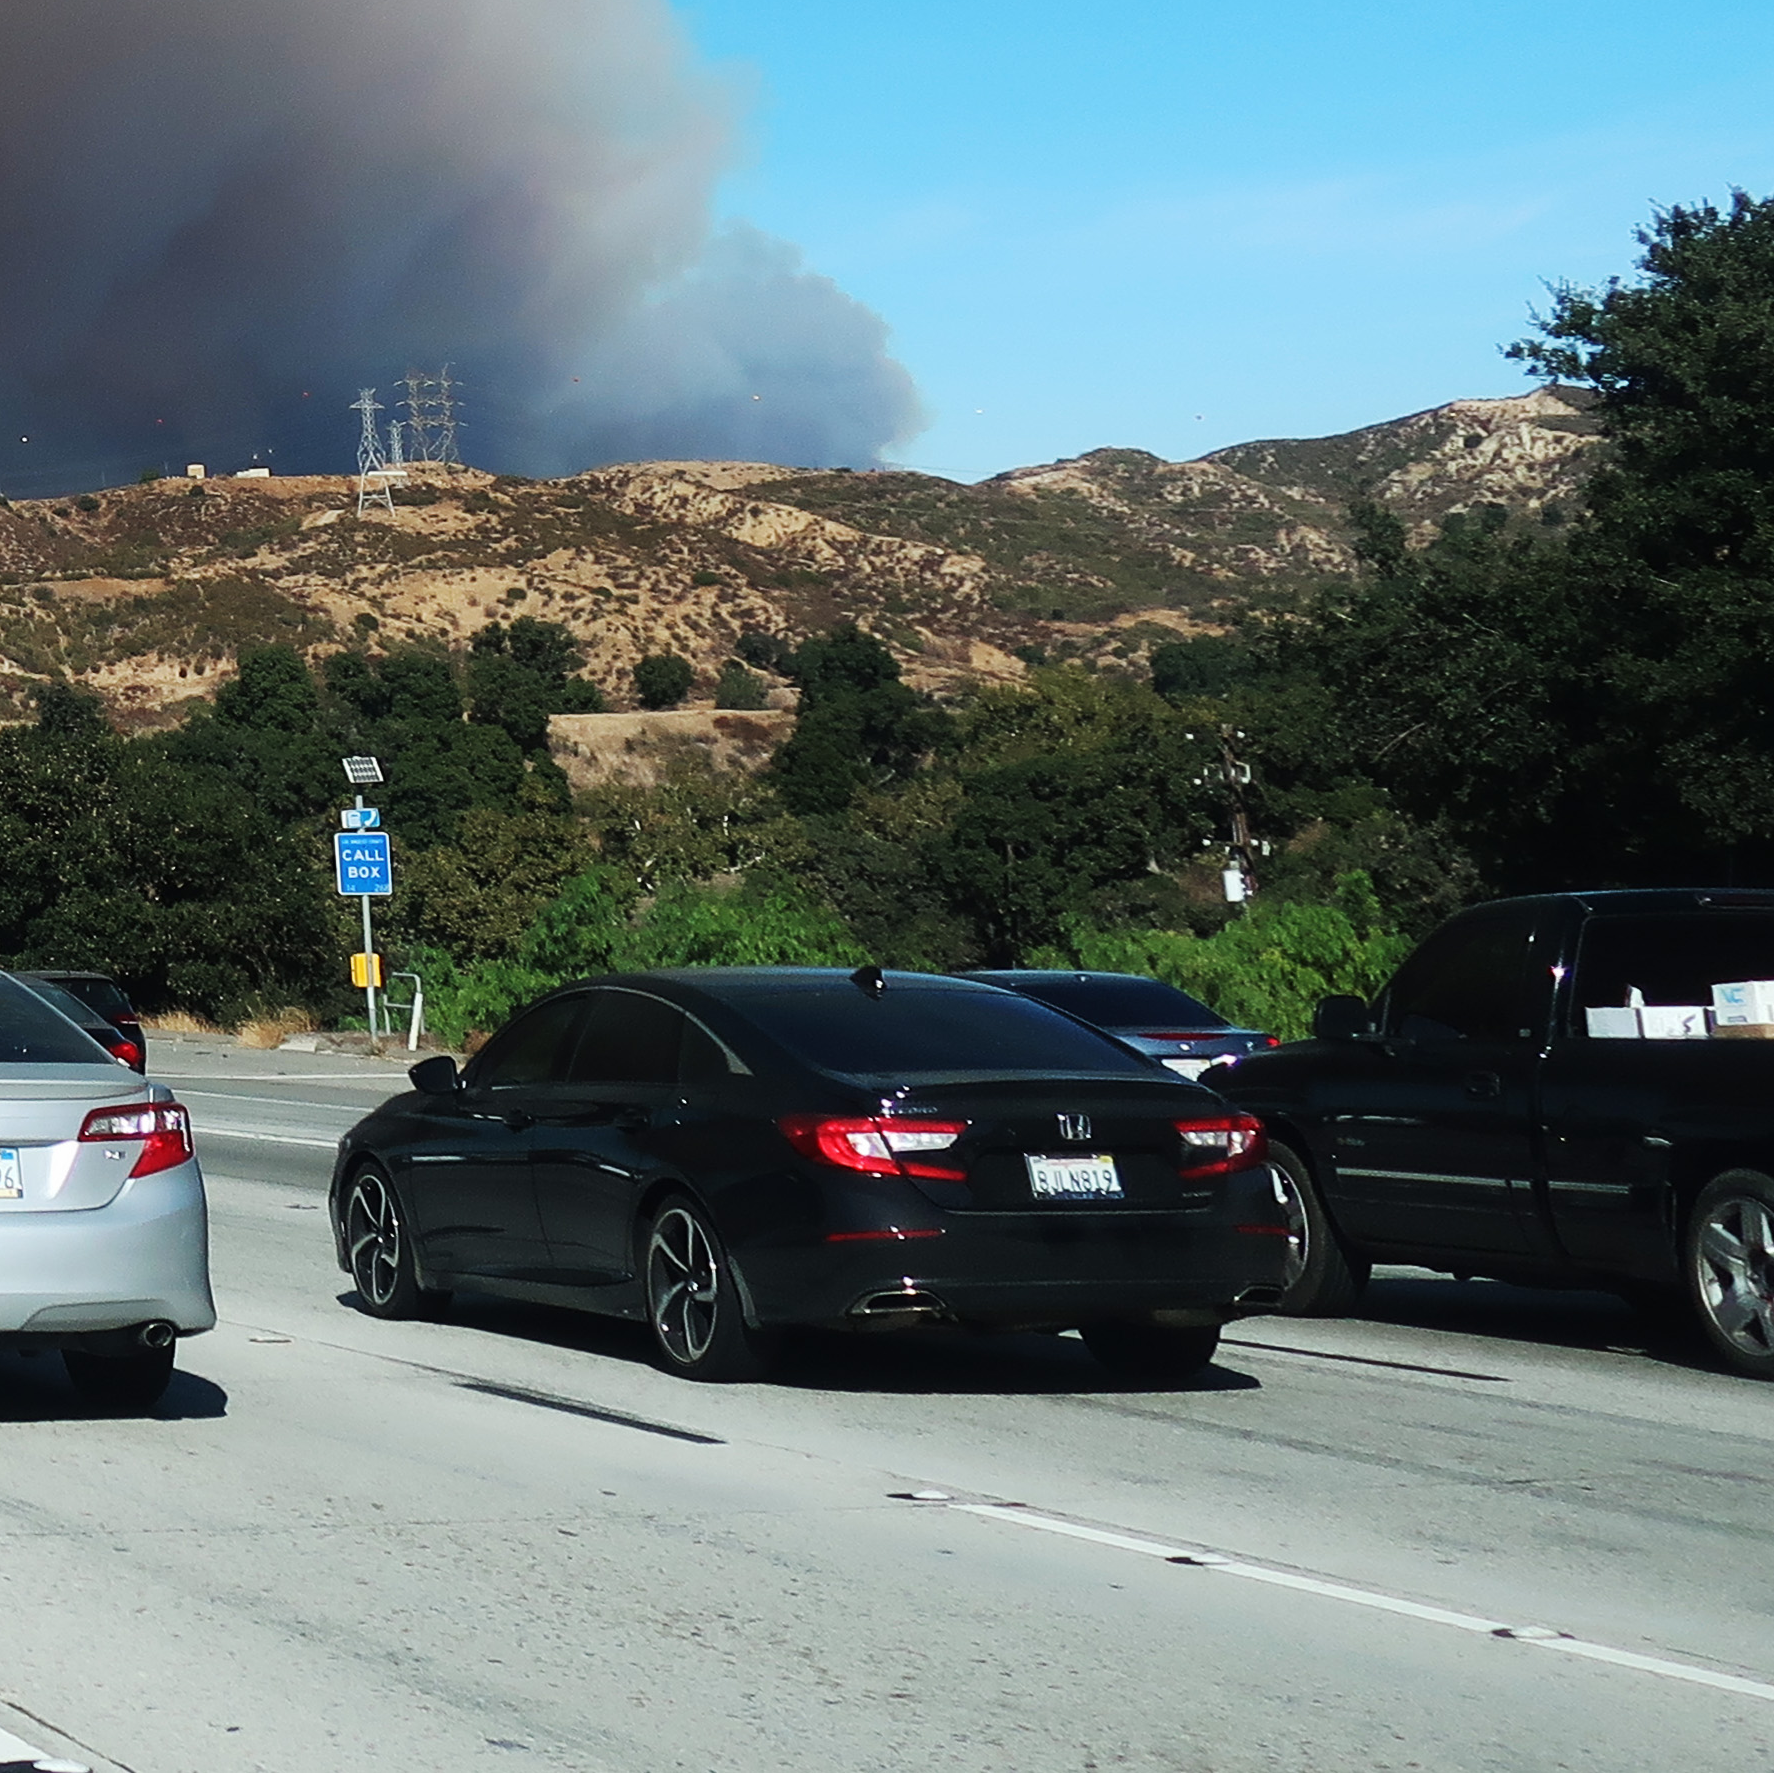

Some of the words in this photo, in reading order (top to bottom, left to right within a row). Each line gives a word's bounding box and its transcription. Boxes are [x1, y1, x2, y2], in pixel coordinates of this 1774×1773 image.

[342, 849, 385, 862] CALL
[347, 866, 381, 879] BOX
[1037, 1169, 1113, 1192] 8JLN819
